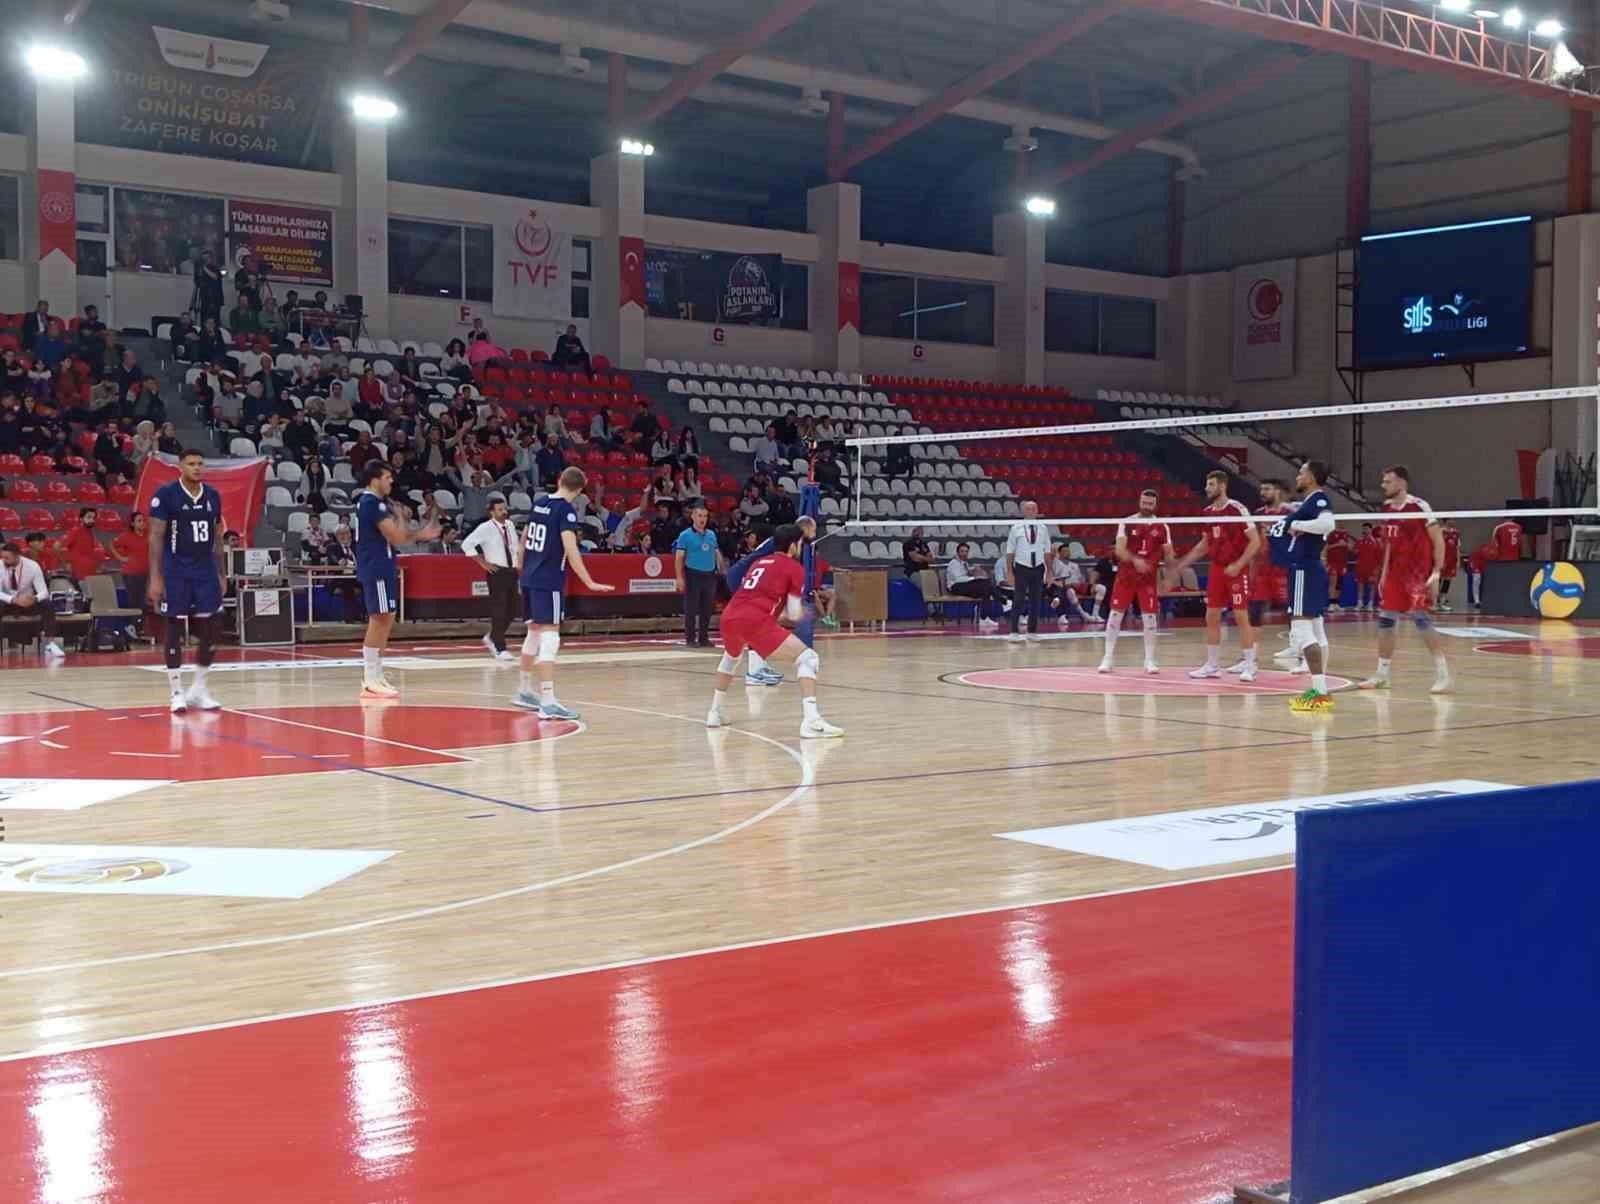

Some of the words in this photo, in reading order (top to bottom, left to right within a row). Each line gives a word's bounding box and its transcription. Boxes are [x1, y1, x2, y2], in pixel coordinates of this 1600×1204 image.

[119, 115, 201, 143] ZAFERE
[508, 260, 558, 288] TVF
[460, 305, 471, 321] F
[713, 327, 724, 342] G
[913, 344, 923, 358] G
[190, 520, 209, 543] 13
[526, 521, 547, 552] 99
[743, 567, 765, 590] 3
